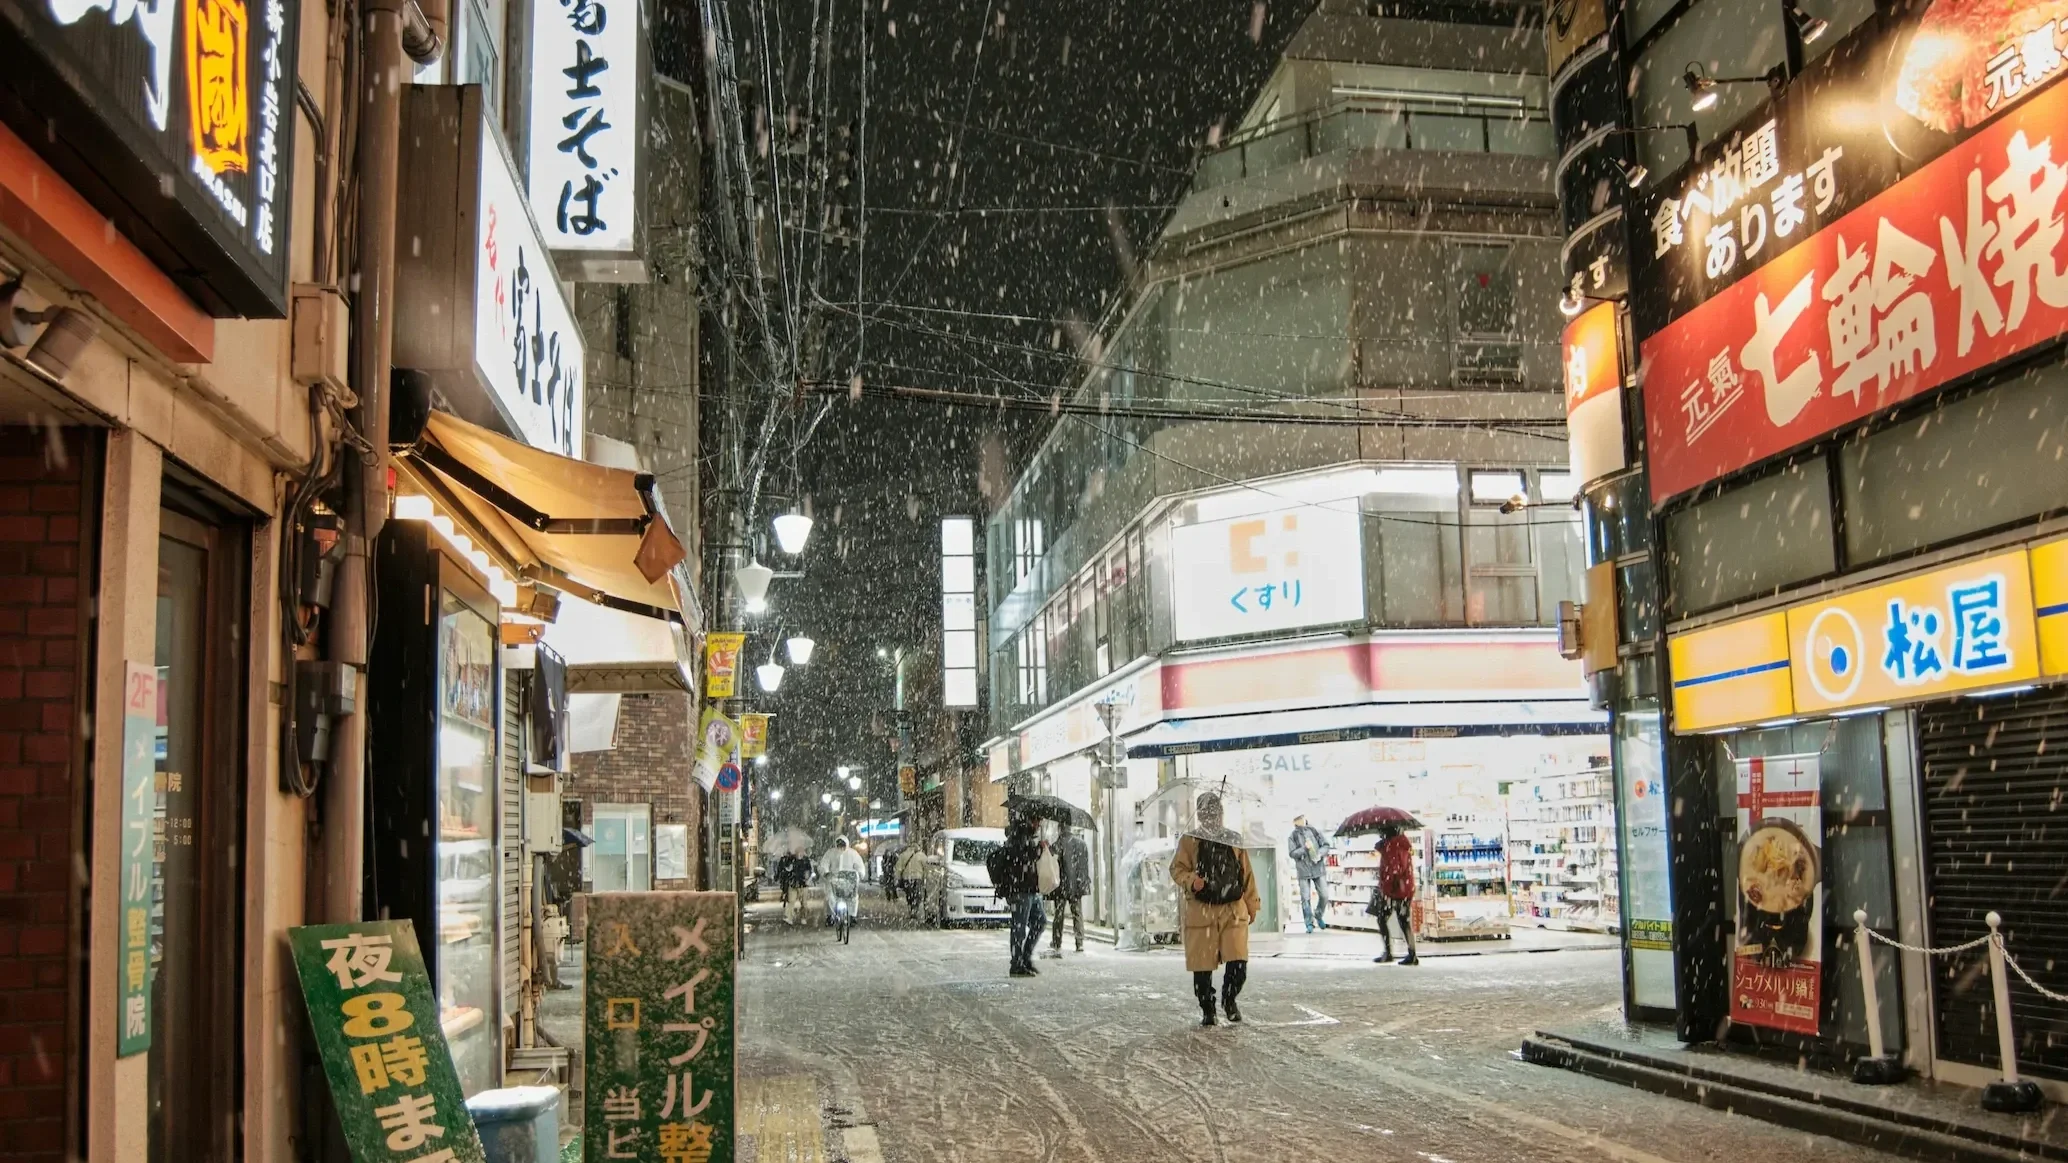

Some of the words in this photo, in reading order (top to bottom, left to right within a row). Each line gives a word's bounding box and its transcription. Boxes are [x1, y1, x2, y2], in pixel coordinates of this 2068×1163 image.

[1984, 17, 2068, 111] 元氣
[1650, 119, 1779, 260] 食べ放題
[1705, 145, 1843, 279] あります
[1231, 579, 1301, 613] くすり
[1883, 578, 2009, 681] 松屋
[130, 672, 153, 709] 2F
[1261, 753, 1312, 771] SALE
[606, 923, 642, 1031] 入口
[320, 933, 459, 1163] 夜8時ま
